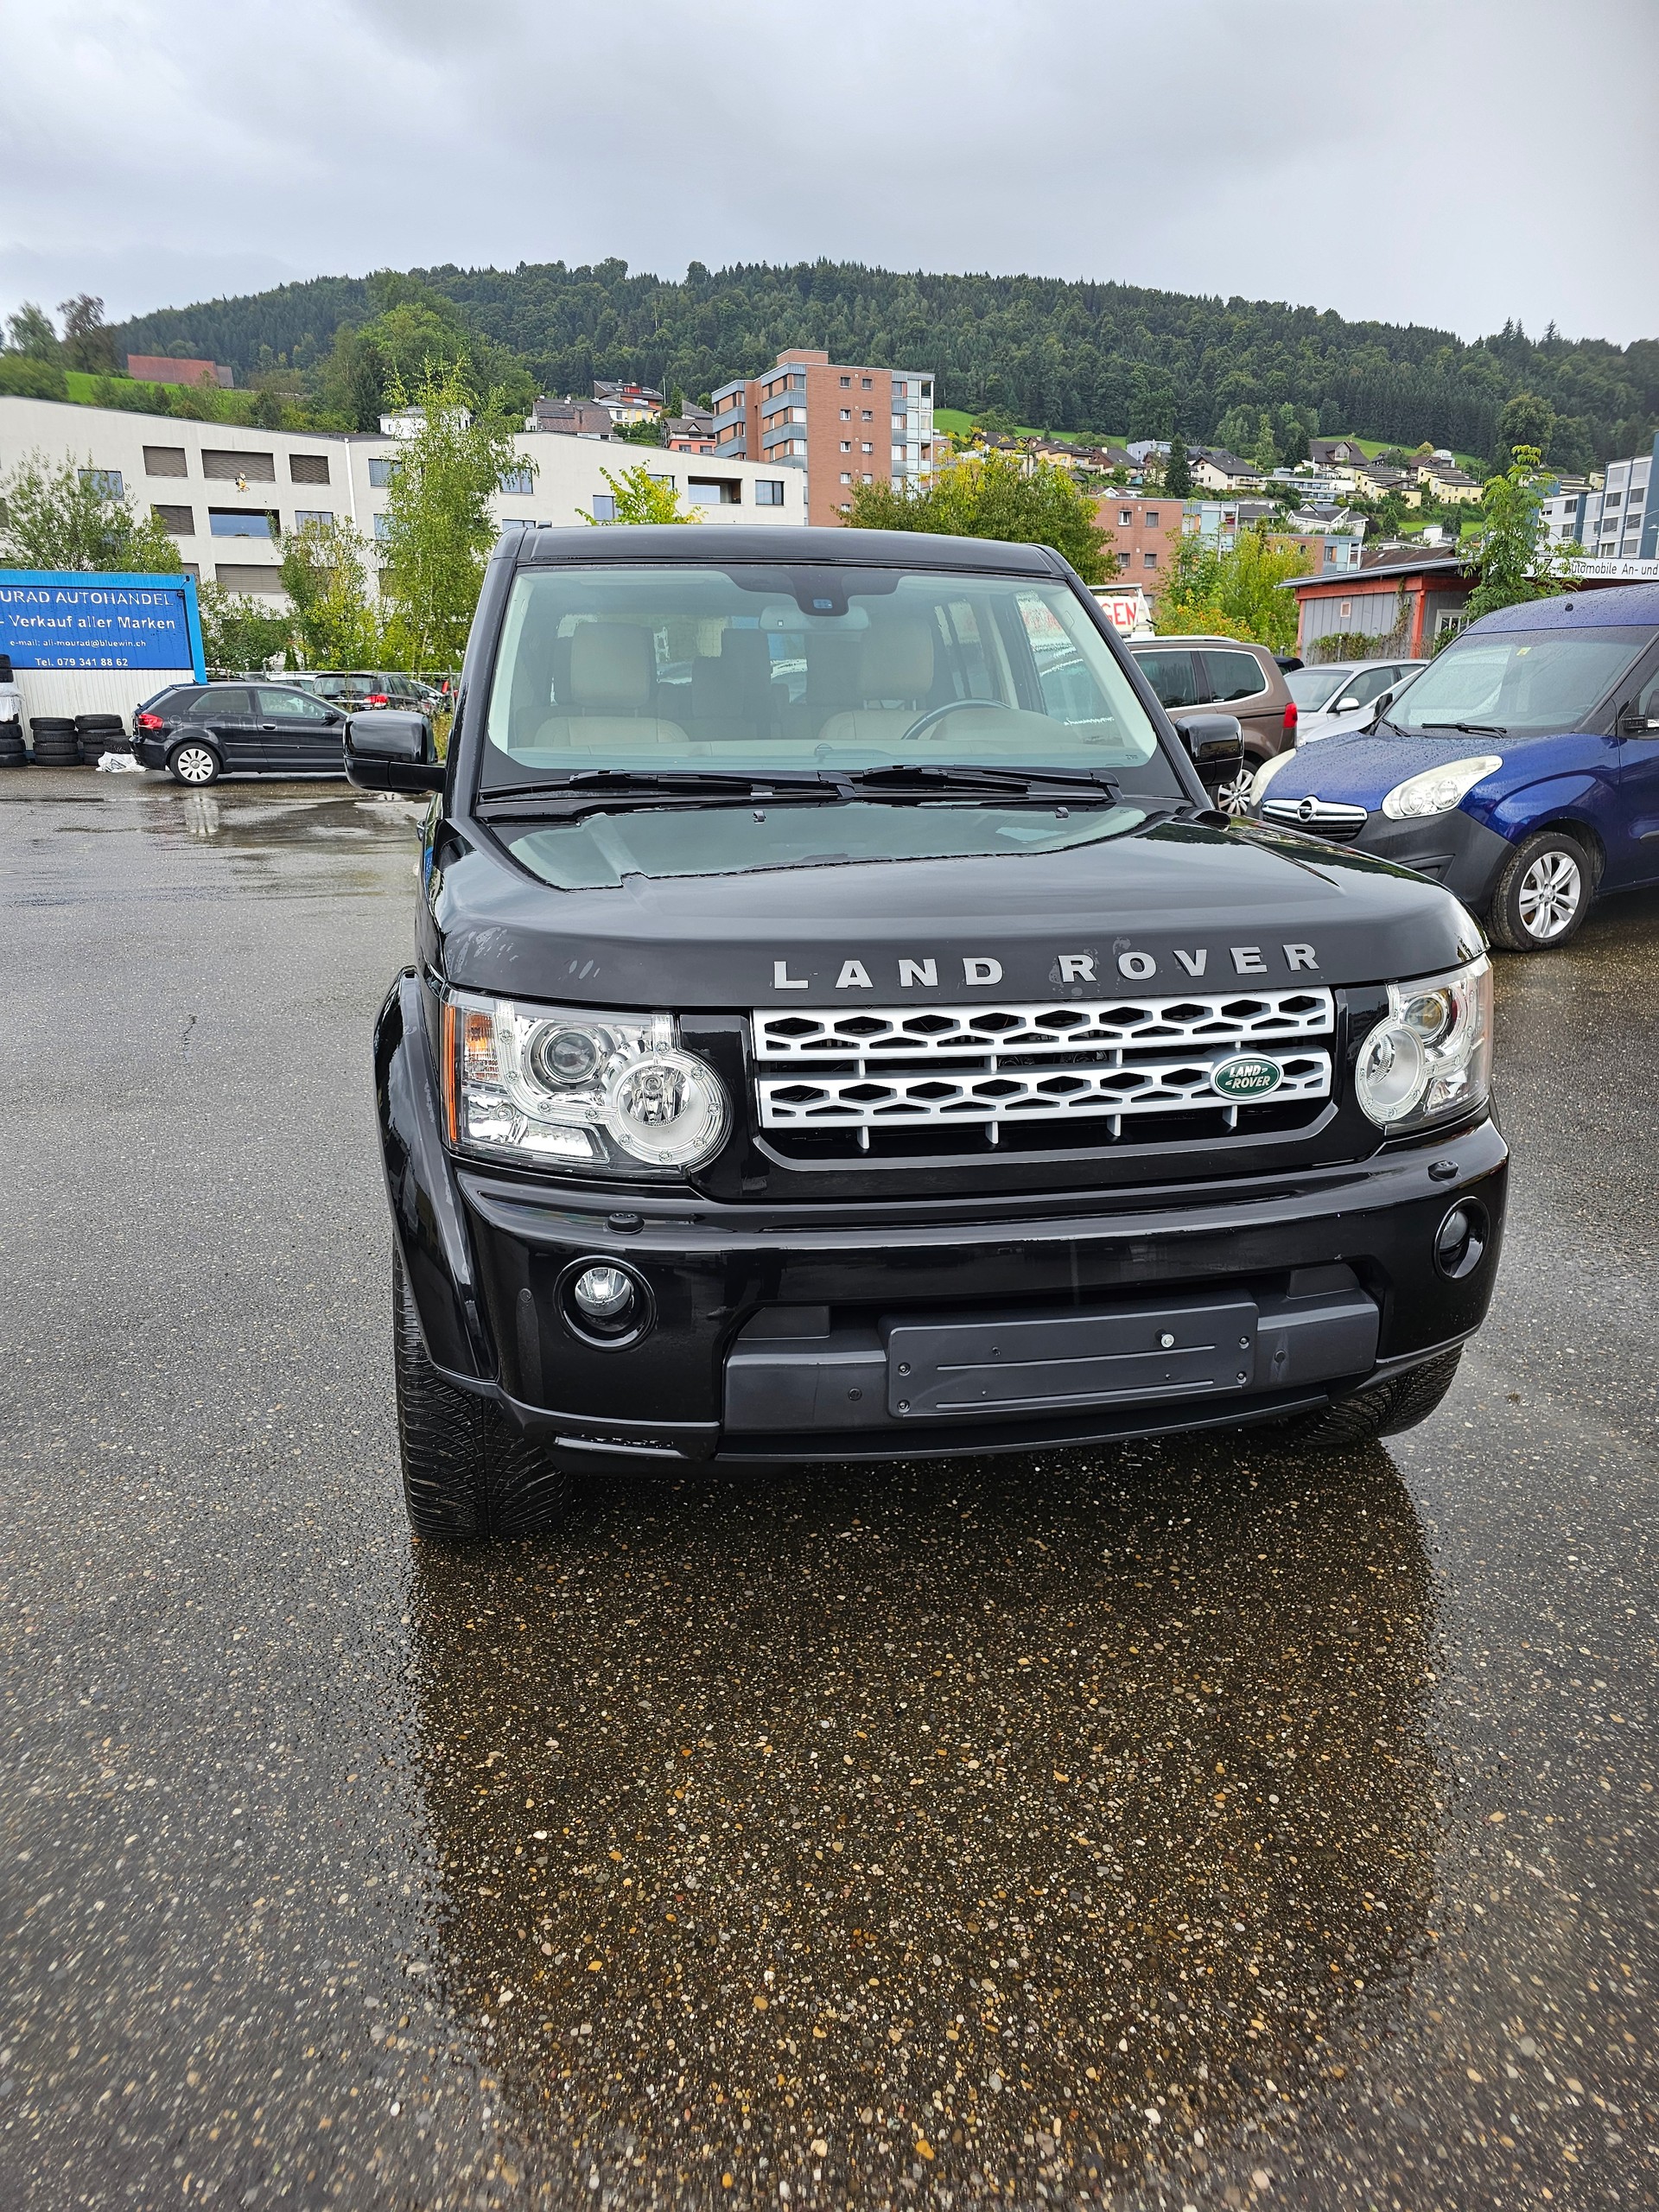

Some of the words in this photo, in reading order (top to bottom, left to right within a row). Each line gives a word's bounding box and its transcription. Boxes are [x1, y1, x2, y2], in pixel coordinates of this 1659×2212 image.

[1621, 563, 1638, 575] An-
[1643, 564, 1658, 575] und
[56, 591, 174, 606] AUTOHANDEL
[9, 614, 73, 627] Verkauf
[79, 615, 112, 628] aller
[118, 616, 175, 629] Marken
[43, 639, 146, 647] ali-mourad@bluewin.ch
[35, 658, 54, 666] Tel.
[57, 658, 76, 666] 079
[79, 658, 97, 666] 341
[101, 658, 113, 666] 88
[773, 959, 1003, 990] LAND
[1058, 943, 1320, 983] ROVER
[1230, 1065, 1262, 1077] LAND
[1232, 1076, 1270, 1089] ROVER
